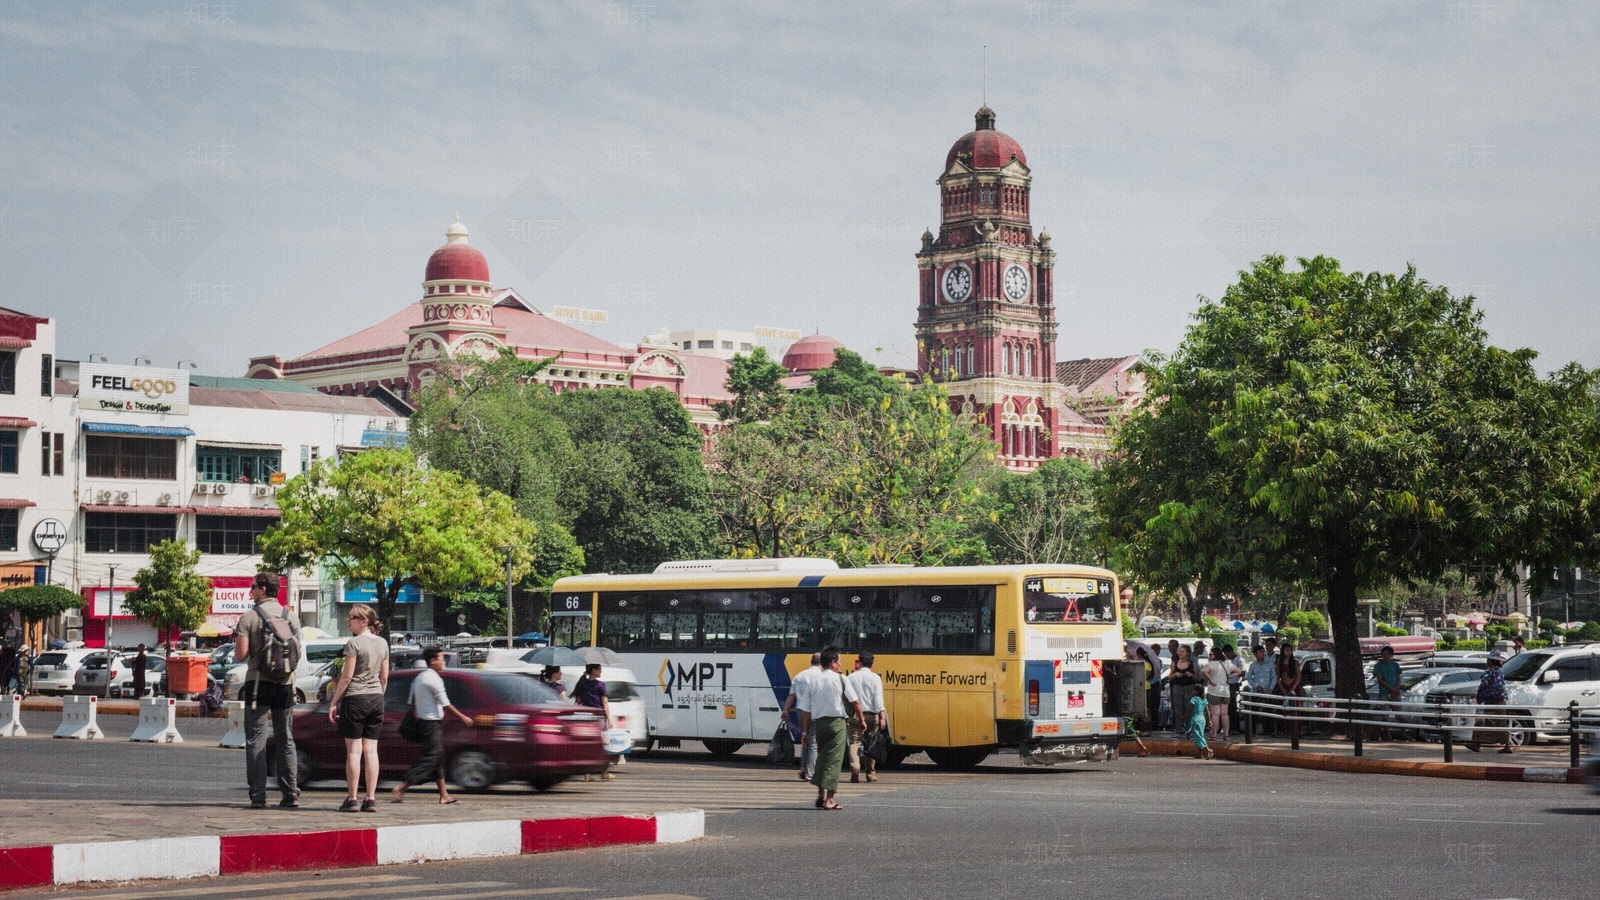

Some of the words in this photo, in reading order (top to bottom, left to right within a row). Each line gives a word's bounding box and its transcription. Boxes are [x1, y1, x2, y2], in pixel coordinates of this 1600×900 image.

[125, 401, 133, 411] &
[216, 592, 245, 601] LUCKY
[566, 596, 579, 609] 66
[1069, 652, 1091, 664] MPT
[677, 662, 733, 692] MPT
[885, 670, 937, 687] Myanmar
[940, 671, 987, 685] Forward
